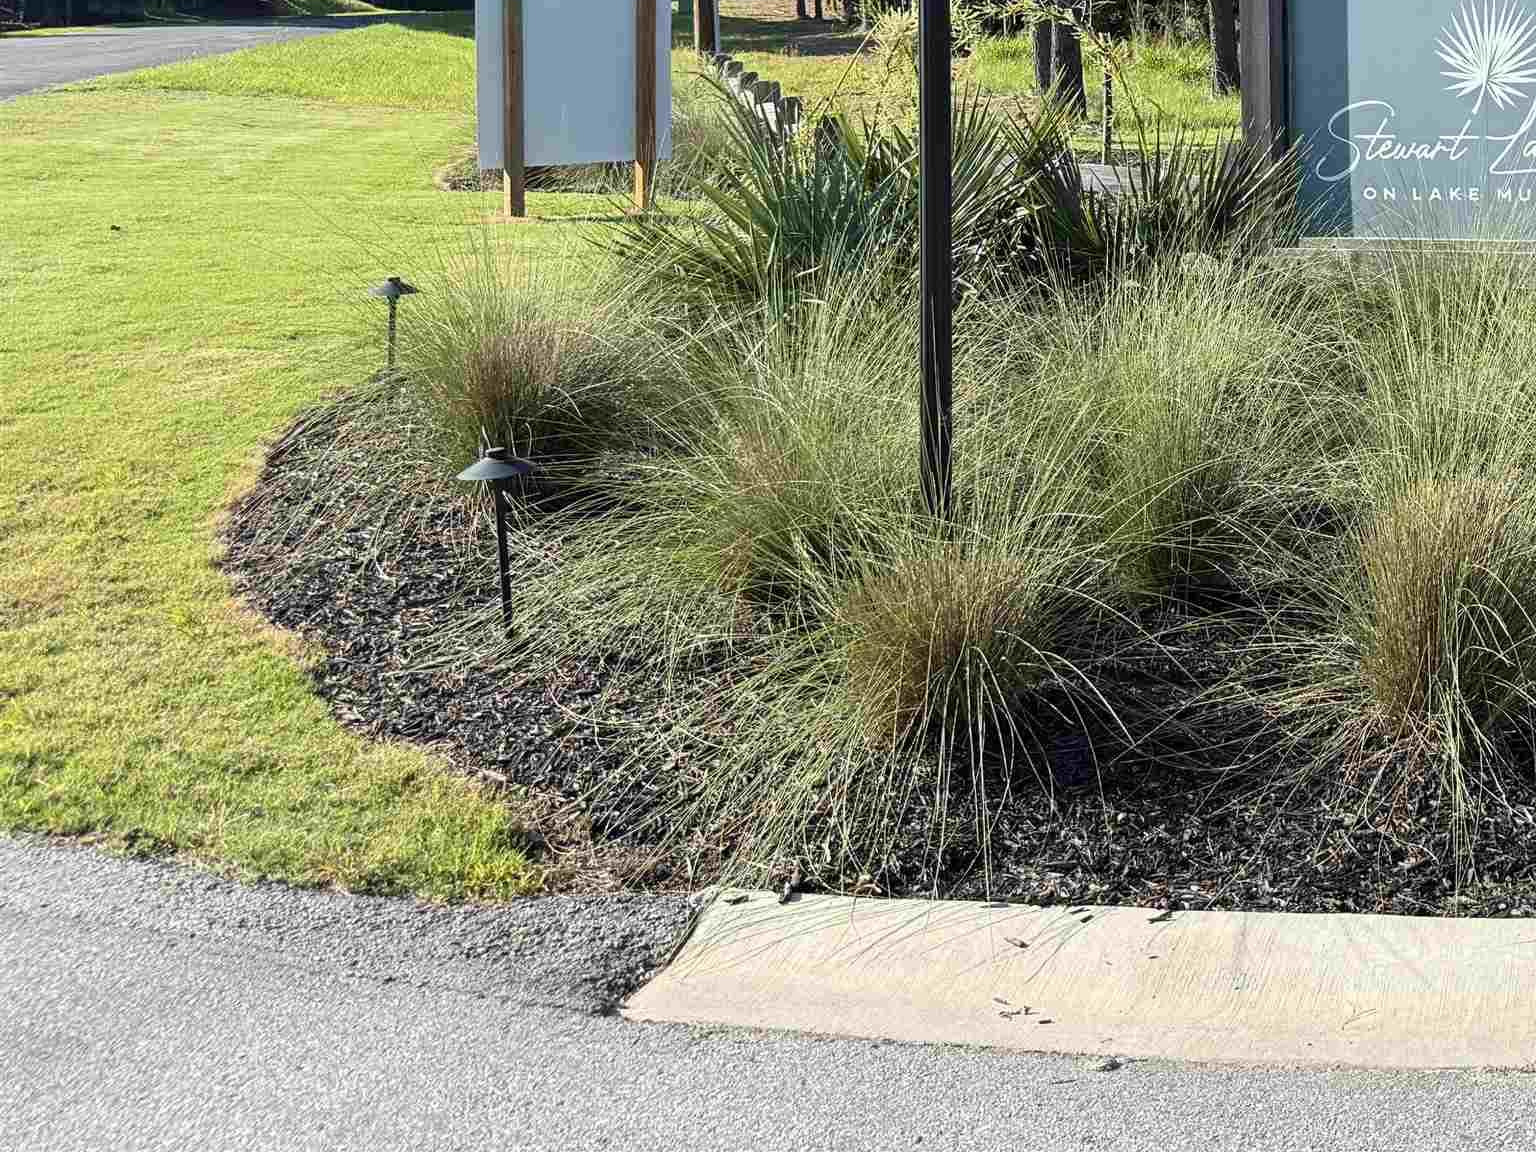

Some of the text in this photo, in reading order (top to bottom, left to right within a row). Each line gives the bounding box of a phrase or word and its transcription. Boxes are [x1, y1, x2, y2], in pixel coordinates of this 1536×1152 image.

[1315, 100, 1480, 182] Stewart
[1362, 187, 1396, 201] ON
[1412, 187, 1480, 201] LAKE
